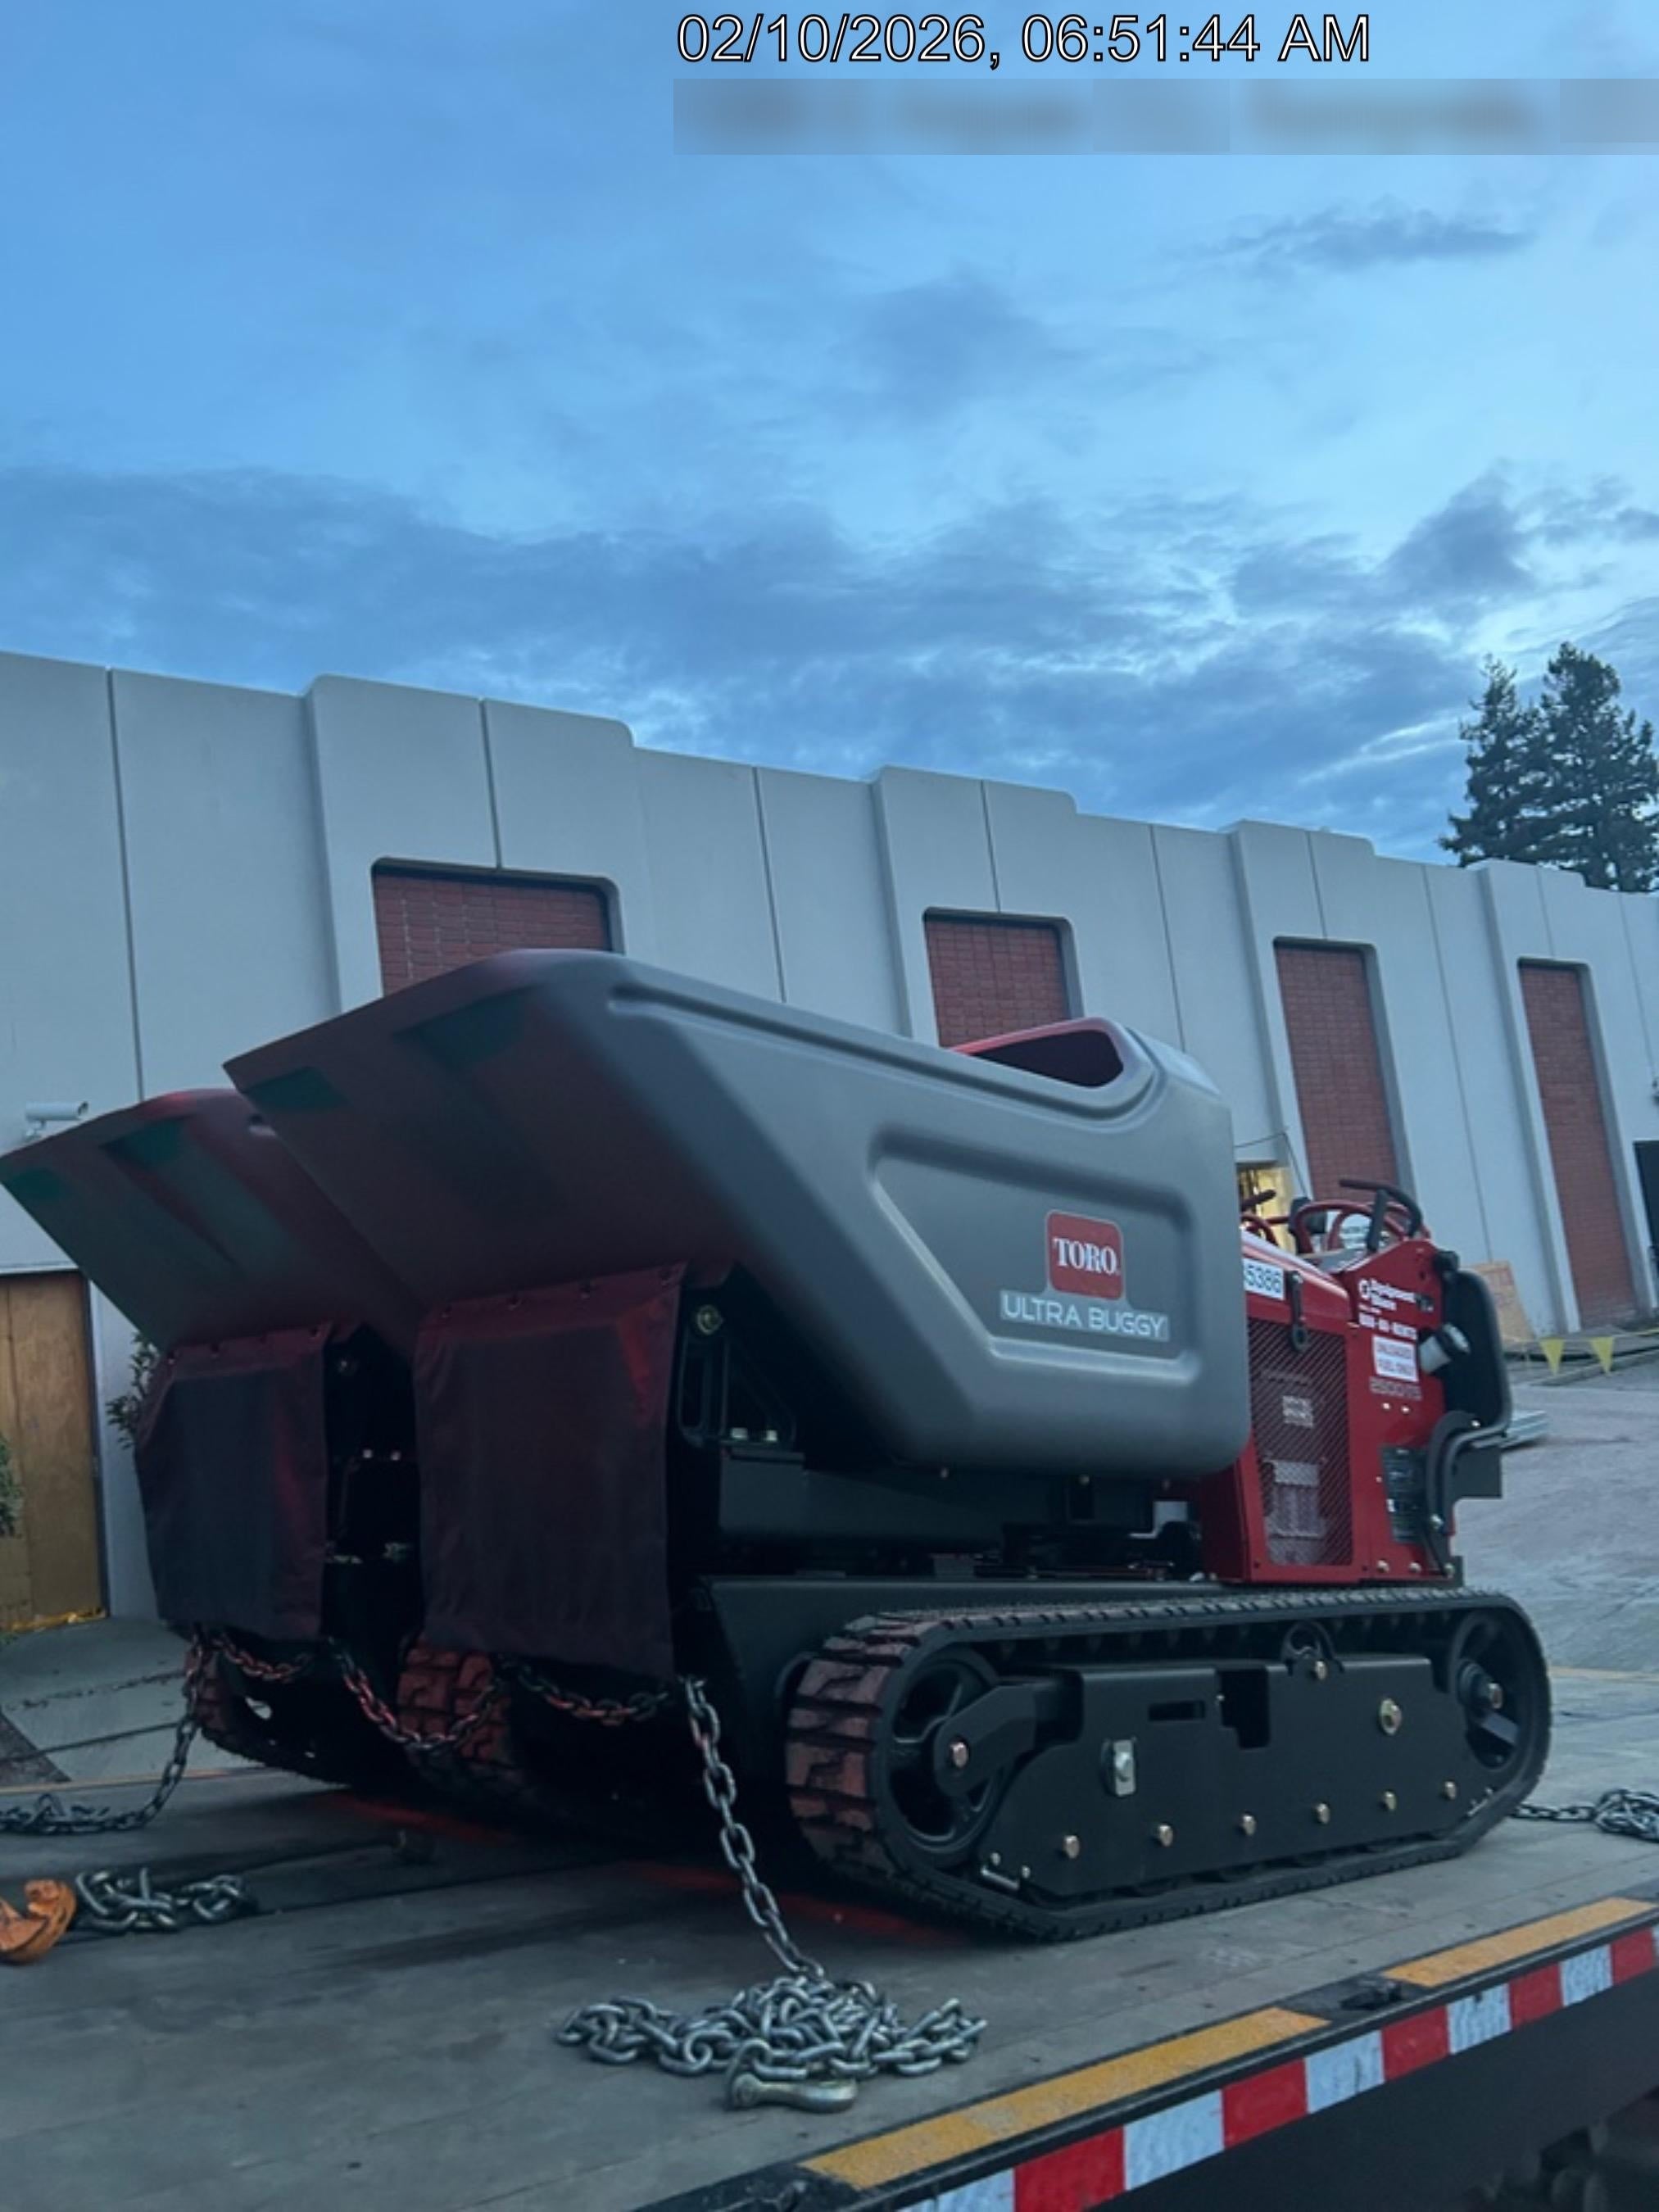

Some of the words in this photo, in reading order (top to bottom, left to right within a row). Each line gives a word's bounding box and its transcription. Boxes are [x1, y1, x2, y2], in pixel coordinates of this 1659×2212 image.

[1054, 1238, 1117, 1275] TORO
[1001, 1294, 1082, 1328] ULTRA
[1087, 1307, 1164, 1339] BUGGY
